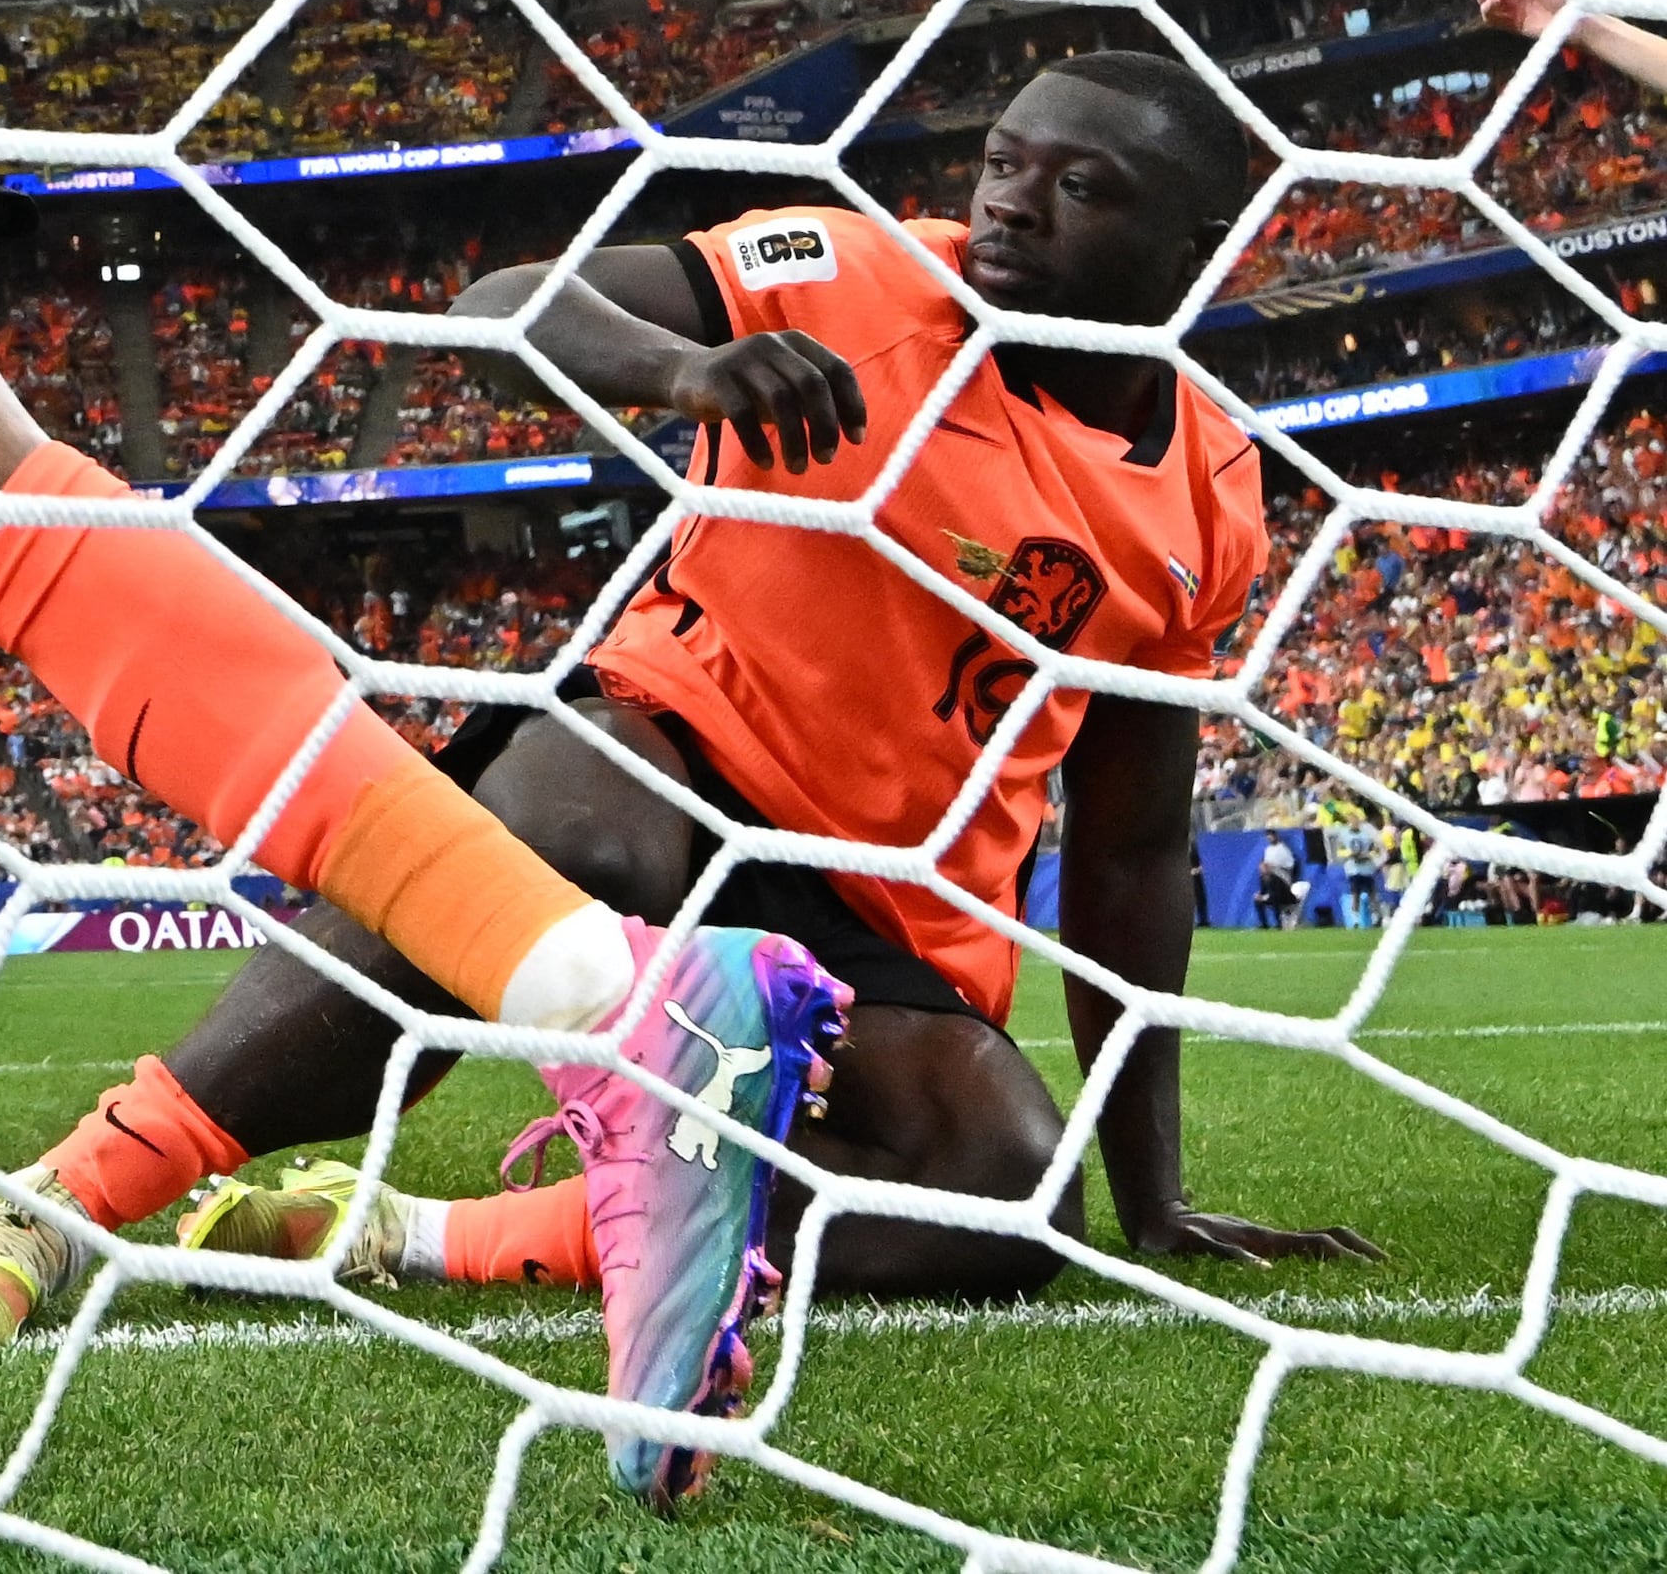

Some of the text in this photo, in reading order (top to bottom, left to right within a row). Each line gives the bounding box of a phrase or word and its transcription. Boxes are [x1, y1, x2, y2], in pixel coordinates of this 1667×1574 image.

[338, 152, 403, 174] WORLD
[403, 148, 440, 168] CUP
[1323, 394, 1361, 422] CUP
